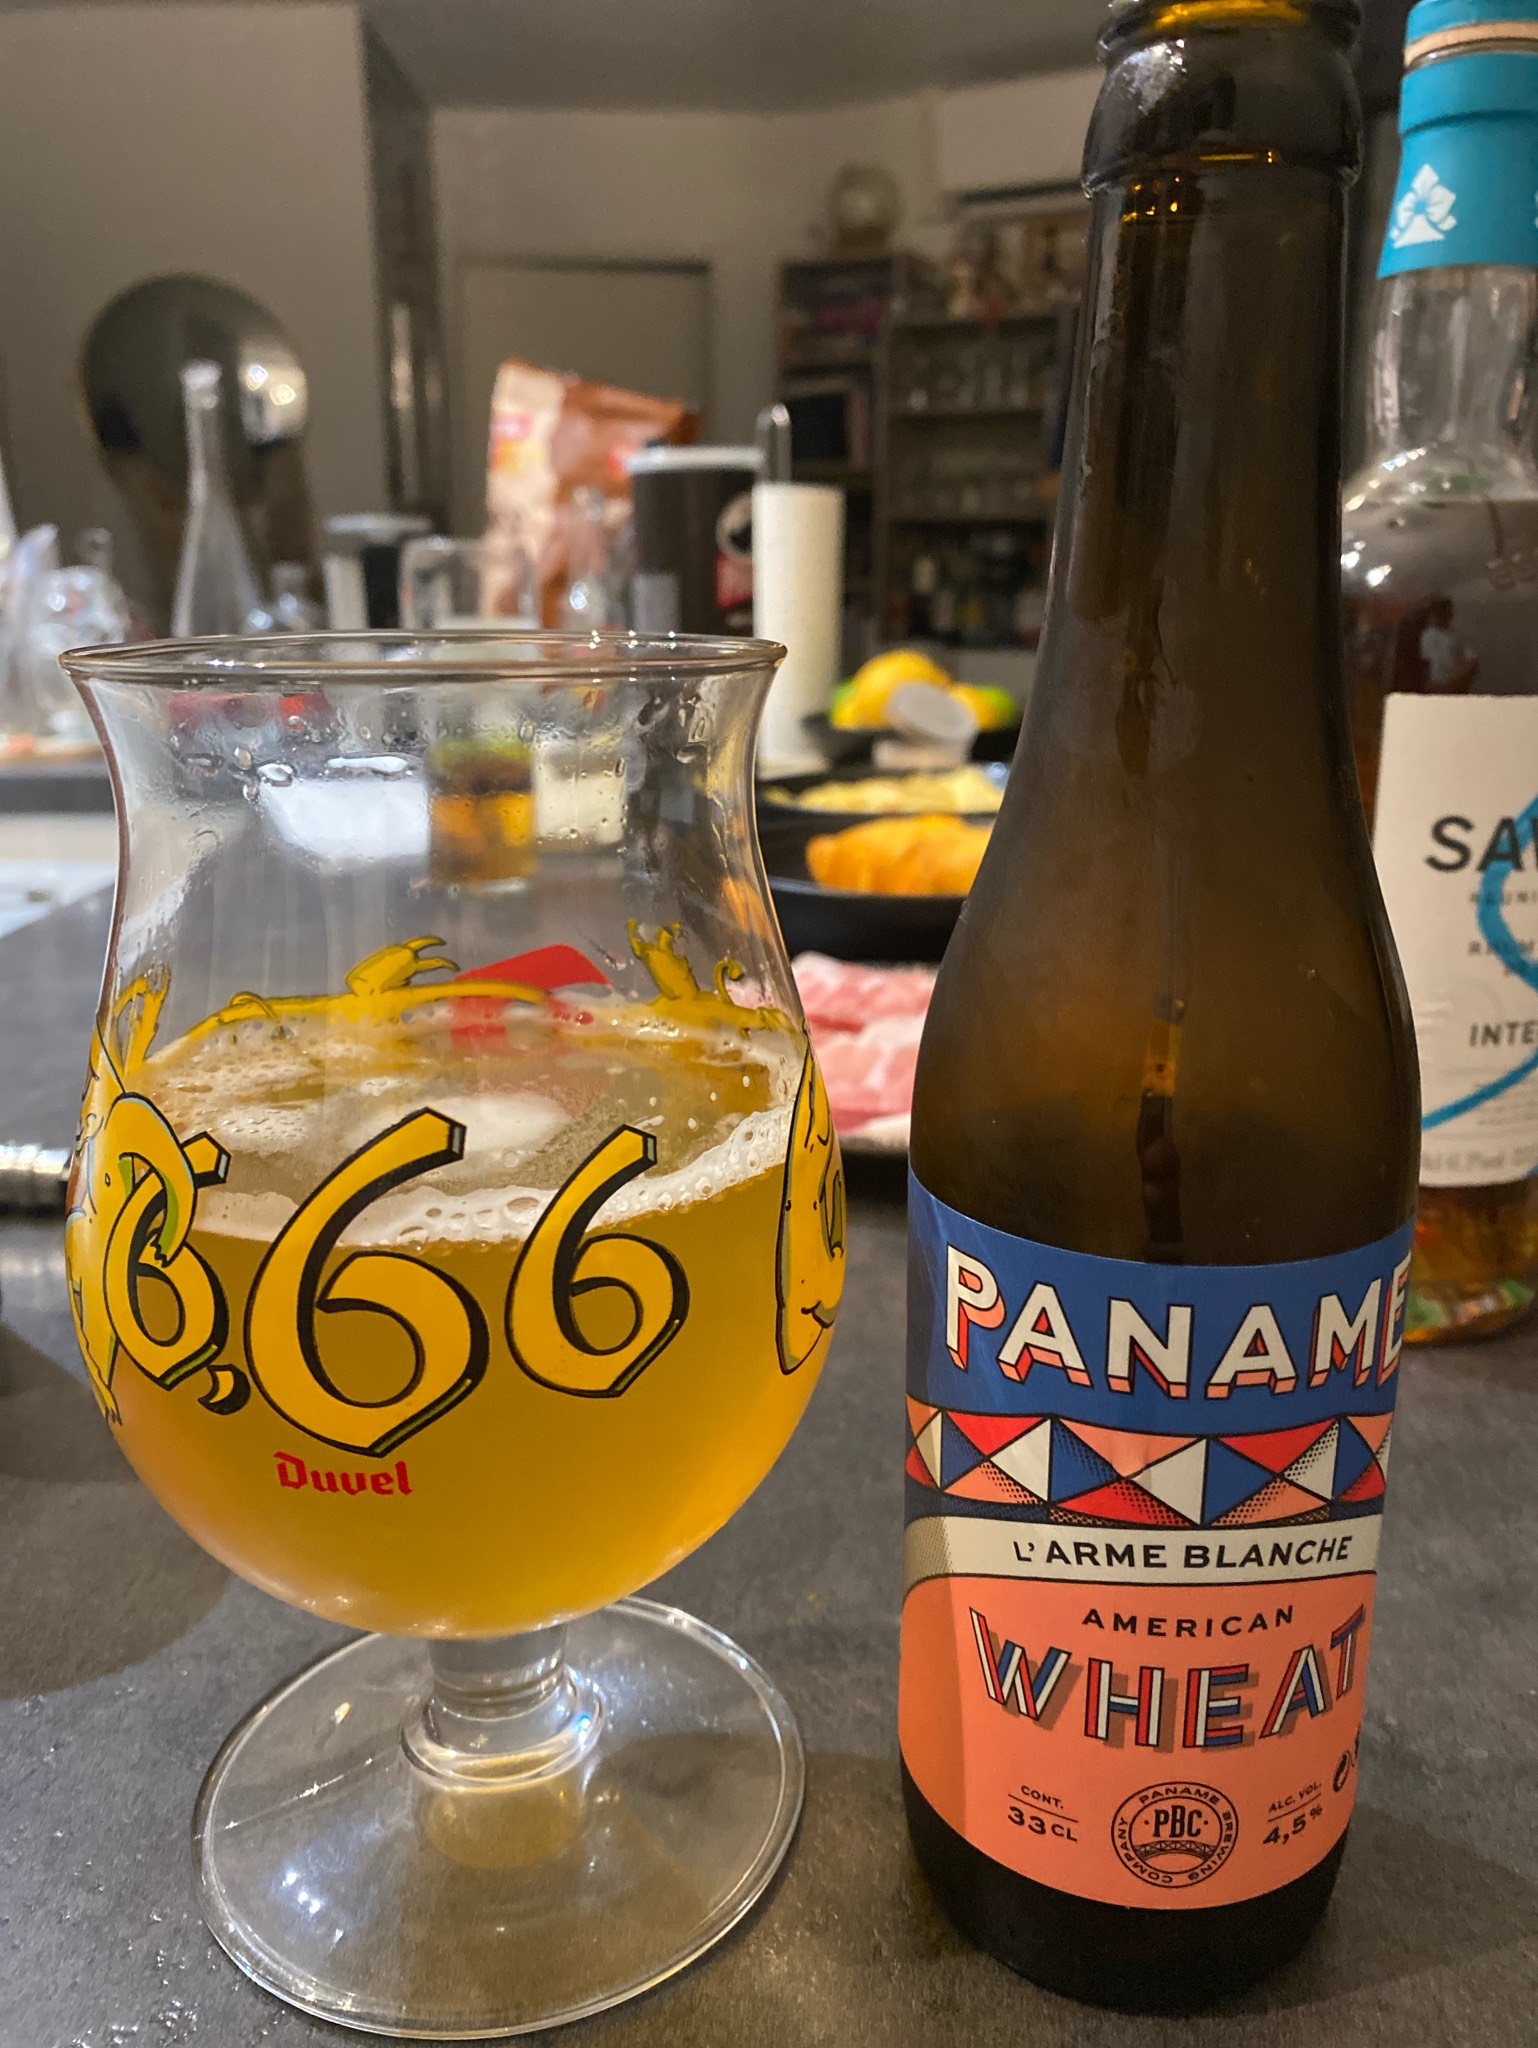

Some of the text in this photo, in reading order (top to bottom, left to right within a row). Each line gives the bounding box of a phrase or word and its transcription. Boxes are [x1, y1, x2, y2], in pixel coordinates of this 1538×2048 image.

[1424, 814, 1538, 873] SA
[946, 1243, 1412, 1399] PANAME
[274, 1452, 412, 1497] Duvel
[1013, 1535, 1353, 1569] L'ARME BLANCHE
[1081, 1604, 1294, 1638] AMERICAN
[969, 1604, 1366, 1750] WHEAT
[1020, 1785, 1064, 1809] CONT.
[1268, 1782, 1321, 1813] ALC. VOL.
[1117, 1787, 1234, 1883] PANAME BREWING COMPANY
[1152, 1804, 1203, 1838] PBC
